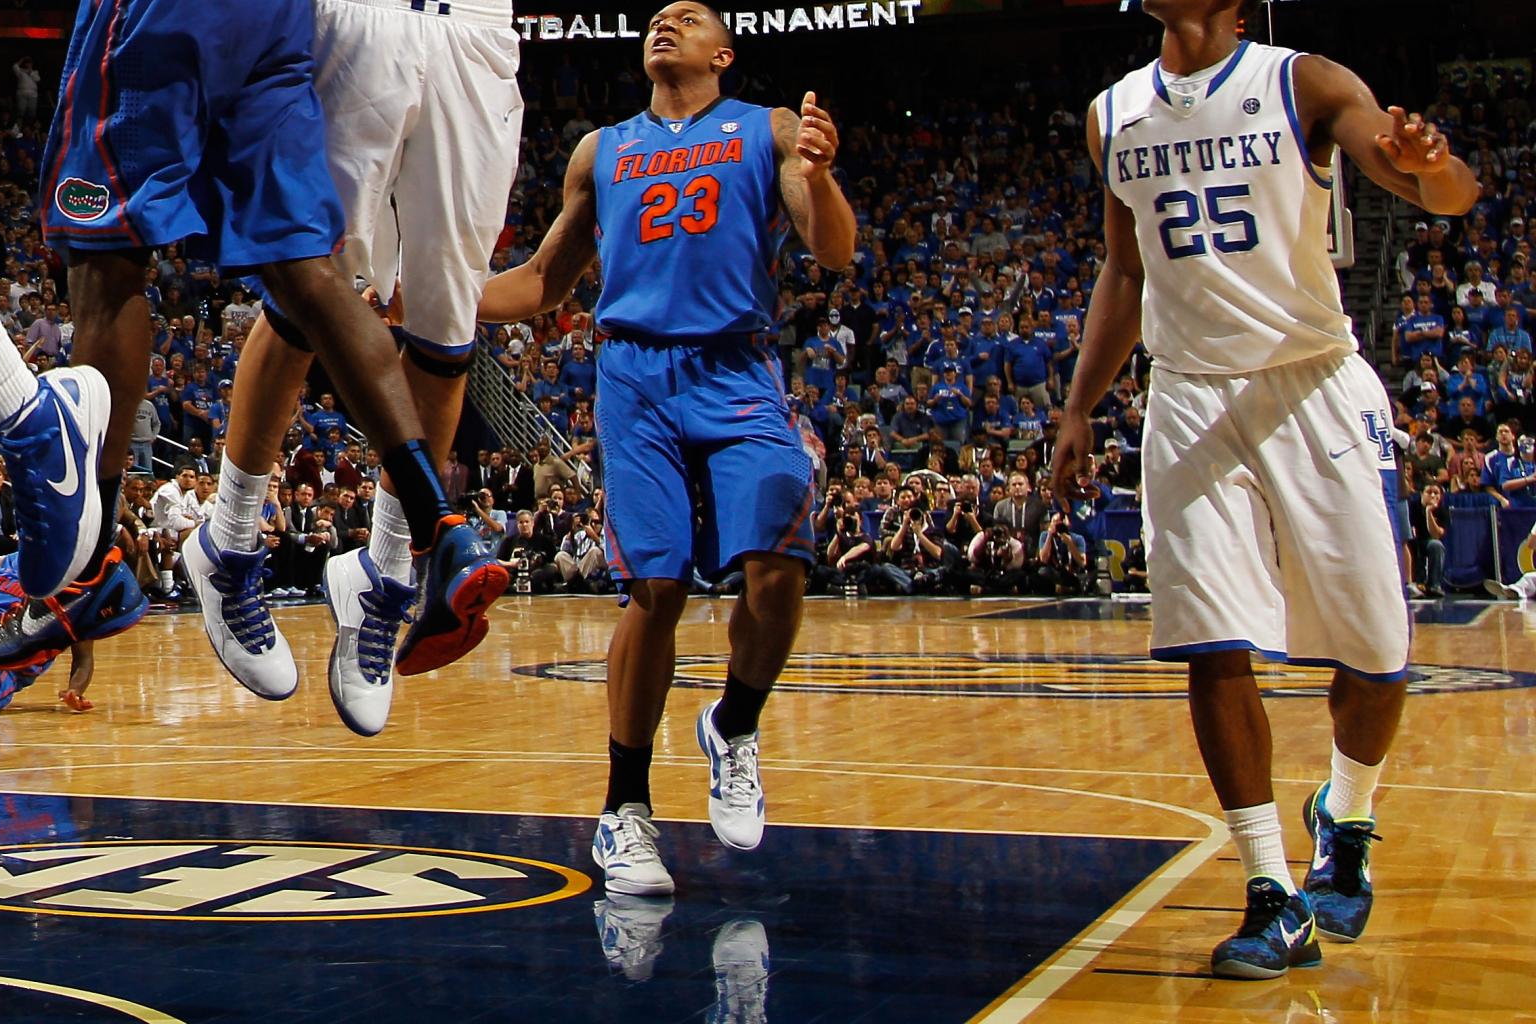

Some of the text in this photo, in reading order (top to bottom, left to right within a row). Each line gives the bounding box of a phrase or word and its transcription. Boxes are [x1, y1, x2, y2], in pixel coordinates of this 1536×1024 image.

[611, 137, 744, 186] FLORIDA
[1116, 131, 1282, 183] KENTUCKY
[639, 174, 721, 245] 23
[1153, 183, 1260, 260] 25
